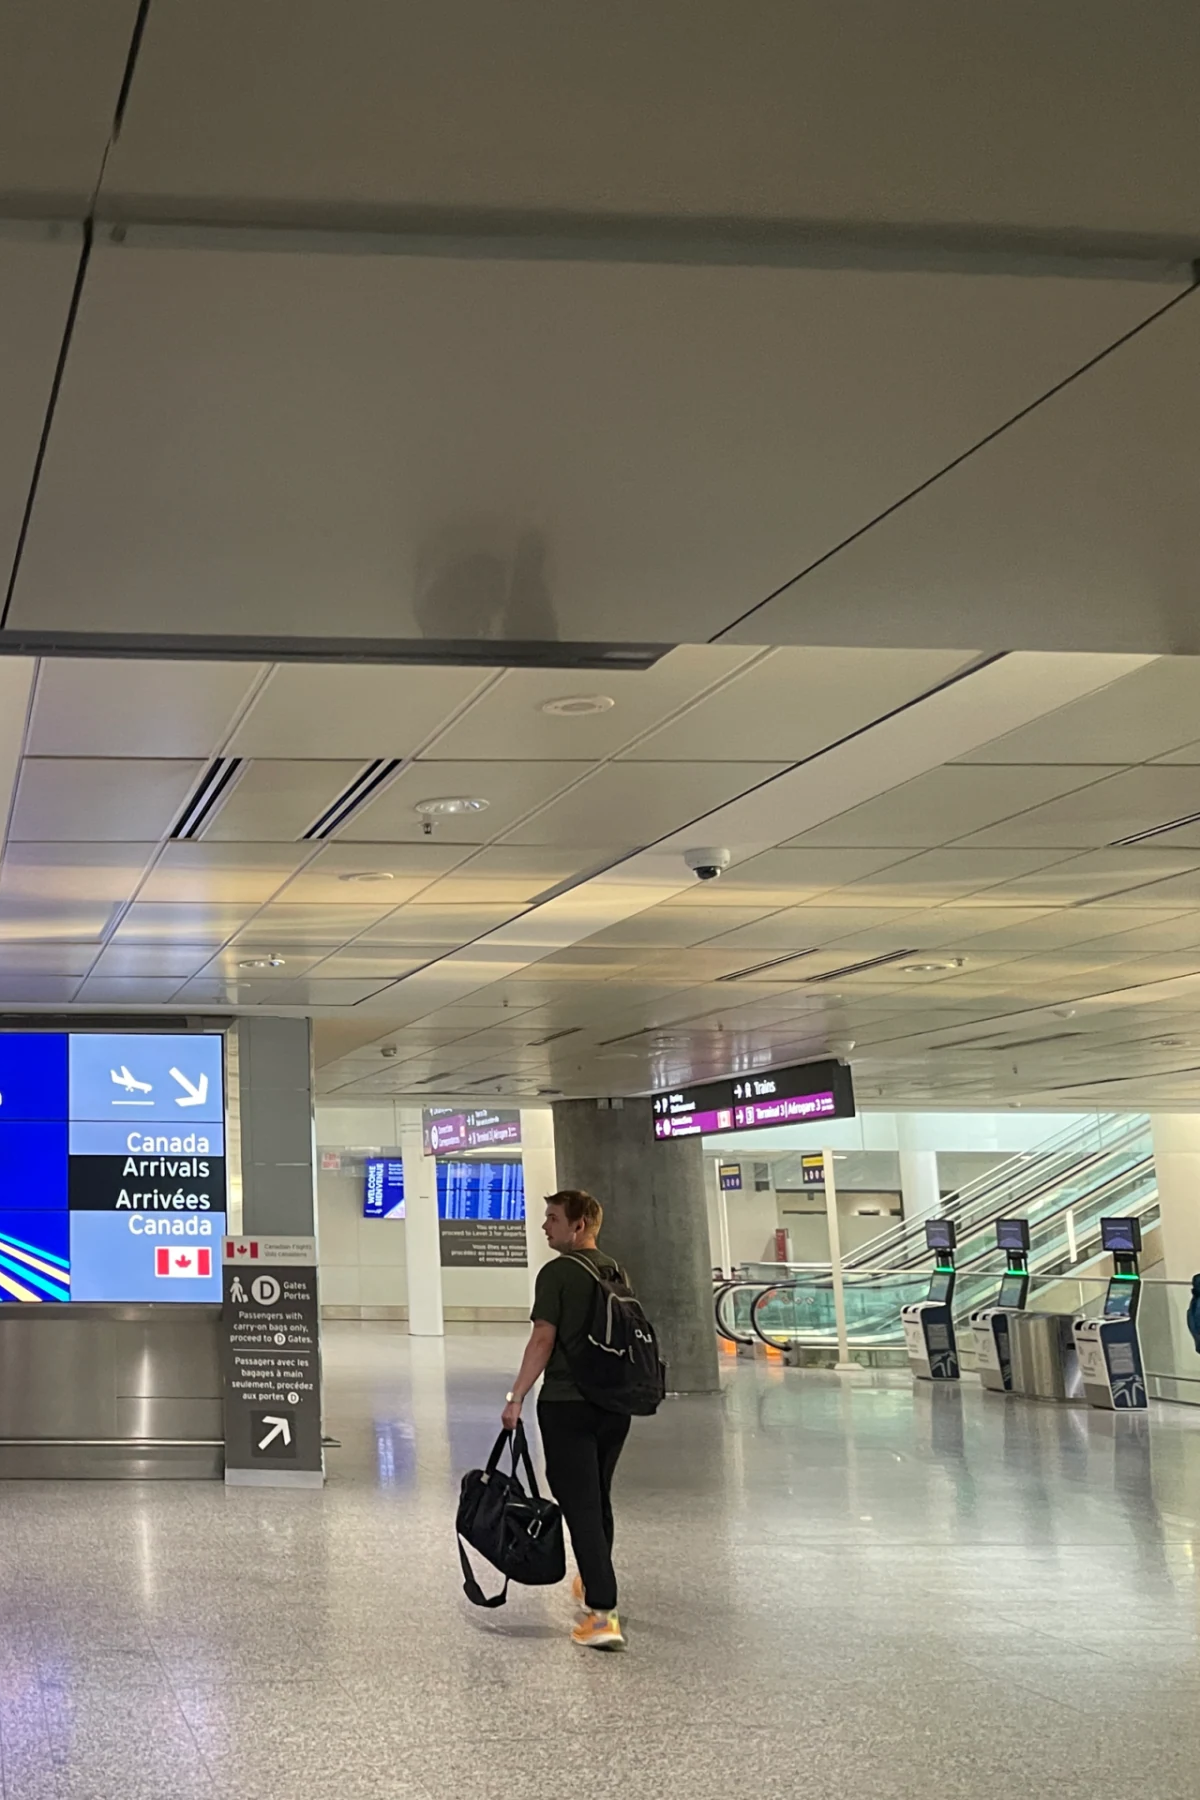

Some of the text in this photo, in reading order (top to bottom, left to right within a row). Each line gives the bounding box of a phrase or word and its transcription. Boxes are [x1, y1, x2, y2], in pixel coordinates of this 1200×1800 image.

[753, 1080, 776, 1096] Trains
[126, 1132, 211, 1154] Canada
[122, 1156, 211, 1178] Arrivals
[367, 1165, 376, 1204] WELCOME
[375, 1163, 384, 1207] BIENVENUE
[115, 1187, 212, 1211] Arrivées
[128, 1213, 213, 1236] Canada
[259, 1280, 275, 1301] D
[283, 1281, 308, 1291] Gates
[283, 1291, 311, 1301] Portes
[238, 1310, 303, 1321] Passengers with
[233, 1323, 267, 1332] carry-on
[269, 1323, 288, 1332] bags
[229, 1334, 262, 1343] proceed
[263, 1335, 272, 1343] to
[234, 1356, 309, 1367] Passagers avec les
[241, 1369, 304, 1379] bagages à main
[276, 1381, 314, 1391] procédez
[242, 1392, 257, 1400] aux
[258, 1393, 285, 1403] portes
